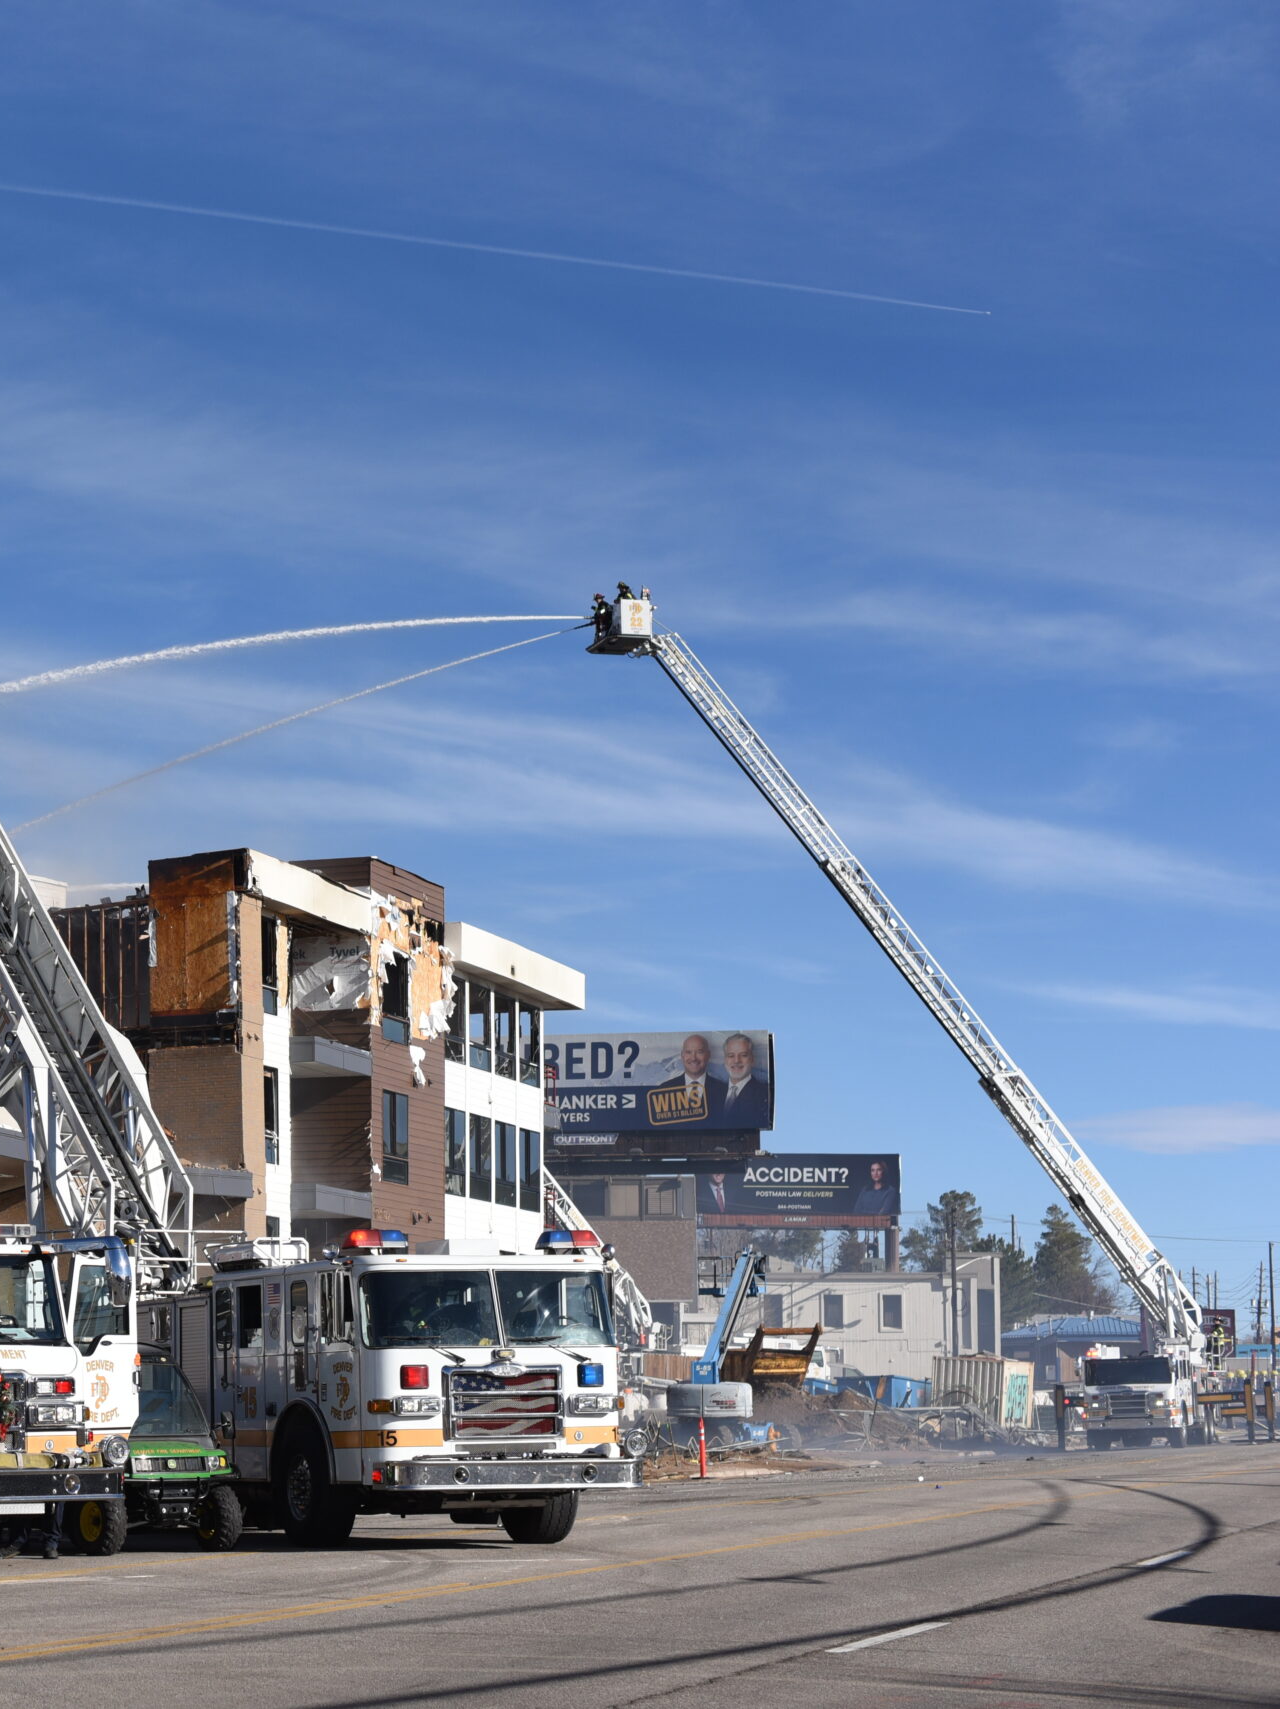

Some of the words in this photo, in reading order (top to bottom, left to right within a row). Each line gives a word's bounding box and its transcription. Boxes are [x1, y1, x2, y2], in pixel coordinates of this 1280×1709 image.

[524, 1040, 640, 1081] RED?
[544, 1093, 618, 1110] HANKER
[652, 1089, 702, 1113] WINS
[559, 1112, 591, 1123] YERS
[656, 1111, 672, 1120] OVER
[680, 1107, 704, 1117] BILLION
[743, 1166, 849, 1183] ACCIDENT?
[755, 1190, 787, 1198] POSTMAN
[788, 1190, 802, 1198] LAW
[802, 1190, 834, 1198] DELIVERS
[1075, 1159, 1101, 1190] DENVER
[1098, 1188, 1116, 1209] FIRE
[1111, 1207, 1152, 1254] DEPARTMENT
[86, 1360, 115, 1372] DENVER
[333, 1362, 353, 1374] DENVER
[241, 1386, 257, 1419] 15
[331, 1406, 342, 1421] FIRE
[377, 1431, 398, 1447] 15
